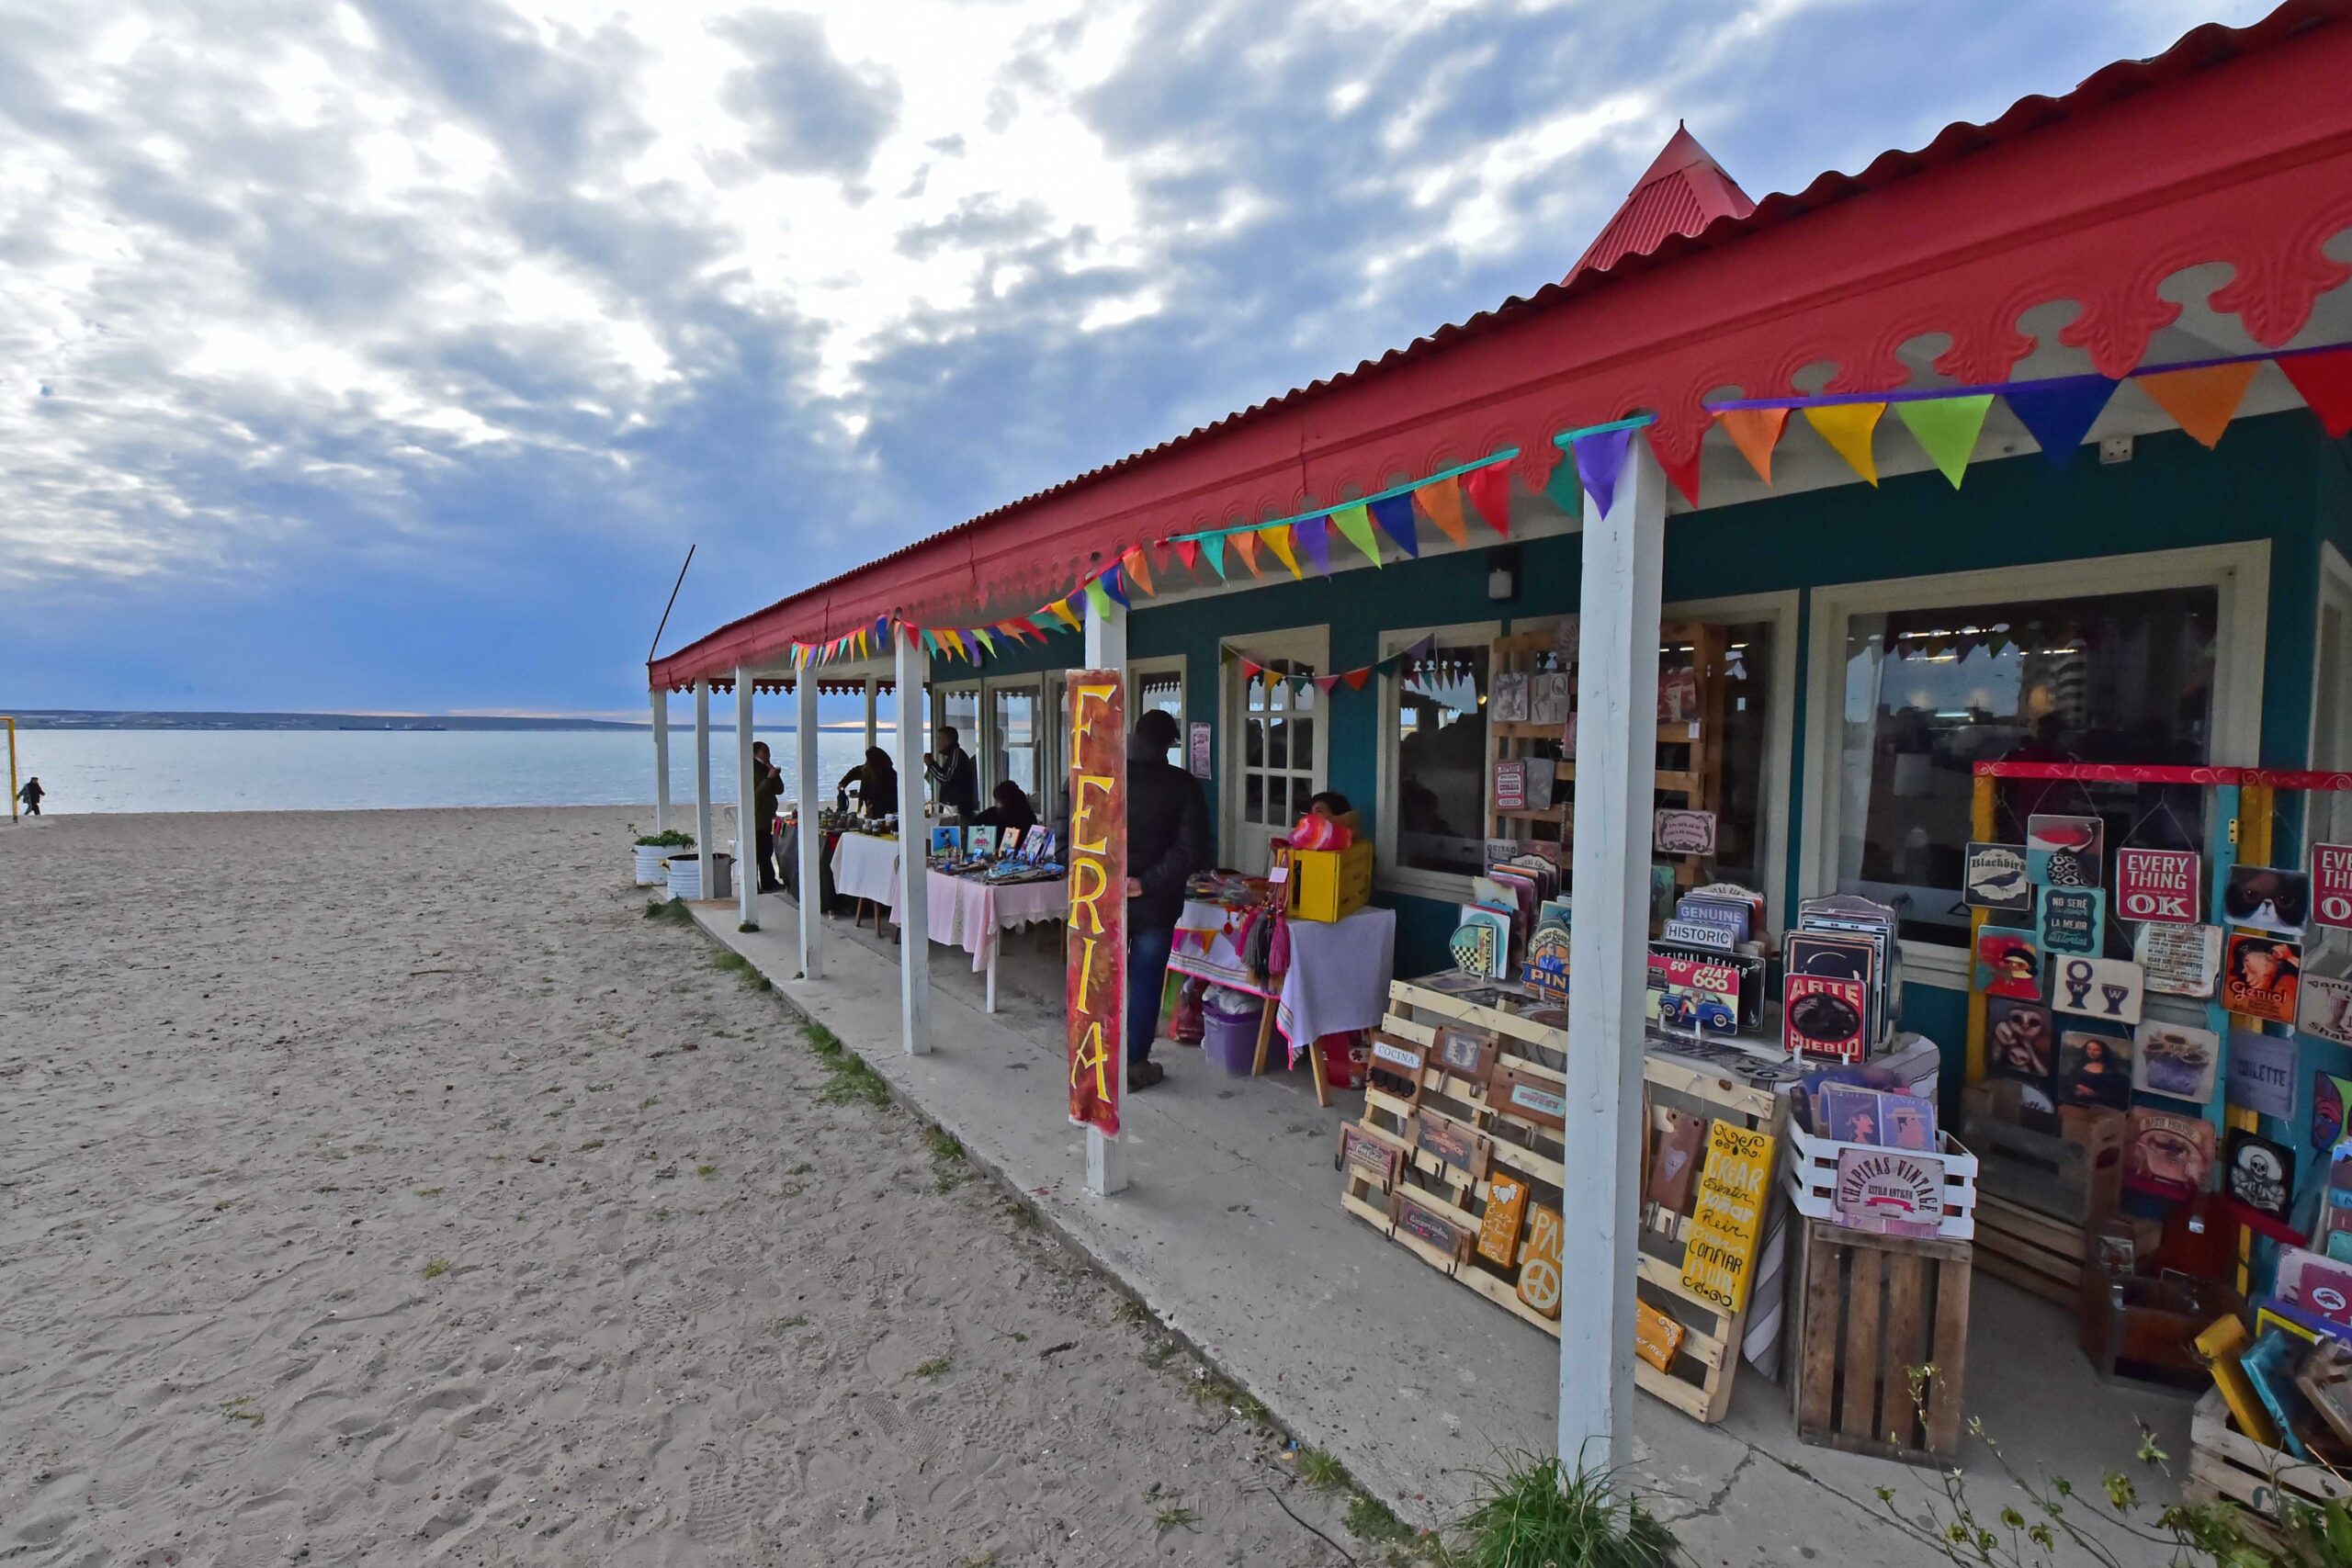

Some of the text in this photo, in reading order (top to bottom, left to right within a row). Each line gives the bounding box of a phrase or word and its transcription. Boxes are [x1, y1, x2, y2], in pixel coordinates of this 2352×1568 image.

[2128, 854, 2189, 873] EVERY
[2128, 871, 2188, 889] THING
[1069, 684, 1117, 1103] FERIA
[2052, 897, 2064, 907] NO
[1680, 907, 1742, 923] GENUINE
[2126, 894, 2190, 918] OK
[1668, 926, 1730, 944] HISTORIC
[2051, 919, 2087, 931] LA MEJOR
[1531, 968, 1566, 989] PIN
[1692, 969, 1729, 991] 600
[1699, 966, 1732, 979] FIAT
[1789, 978, 1860, 1007] ARTE
[2231, 980, 2288, 1004] Geniol
[1790, 1028, 1860, 1056] PUEBLO
[1378, 1045, 1415, 1065] COCINA
[1841, 1156, 1938, 1213] CHAPITAS VINTAGE
[1868, 1185, 1914, 1201] ESTILO ANTIGUO
[1532, 1212, 1565, 1265] PA
